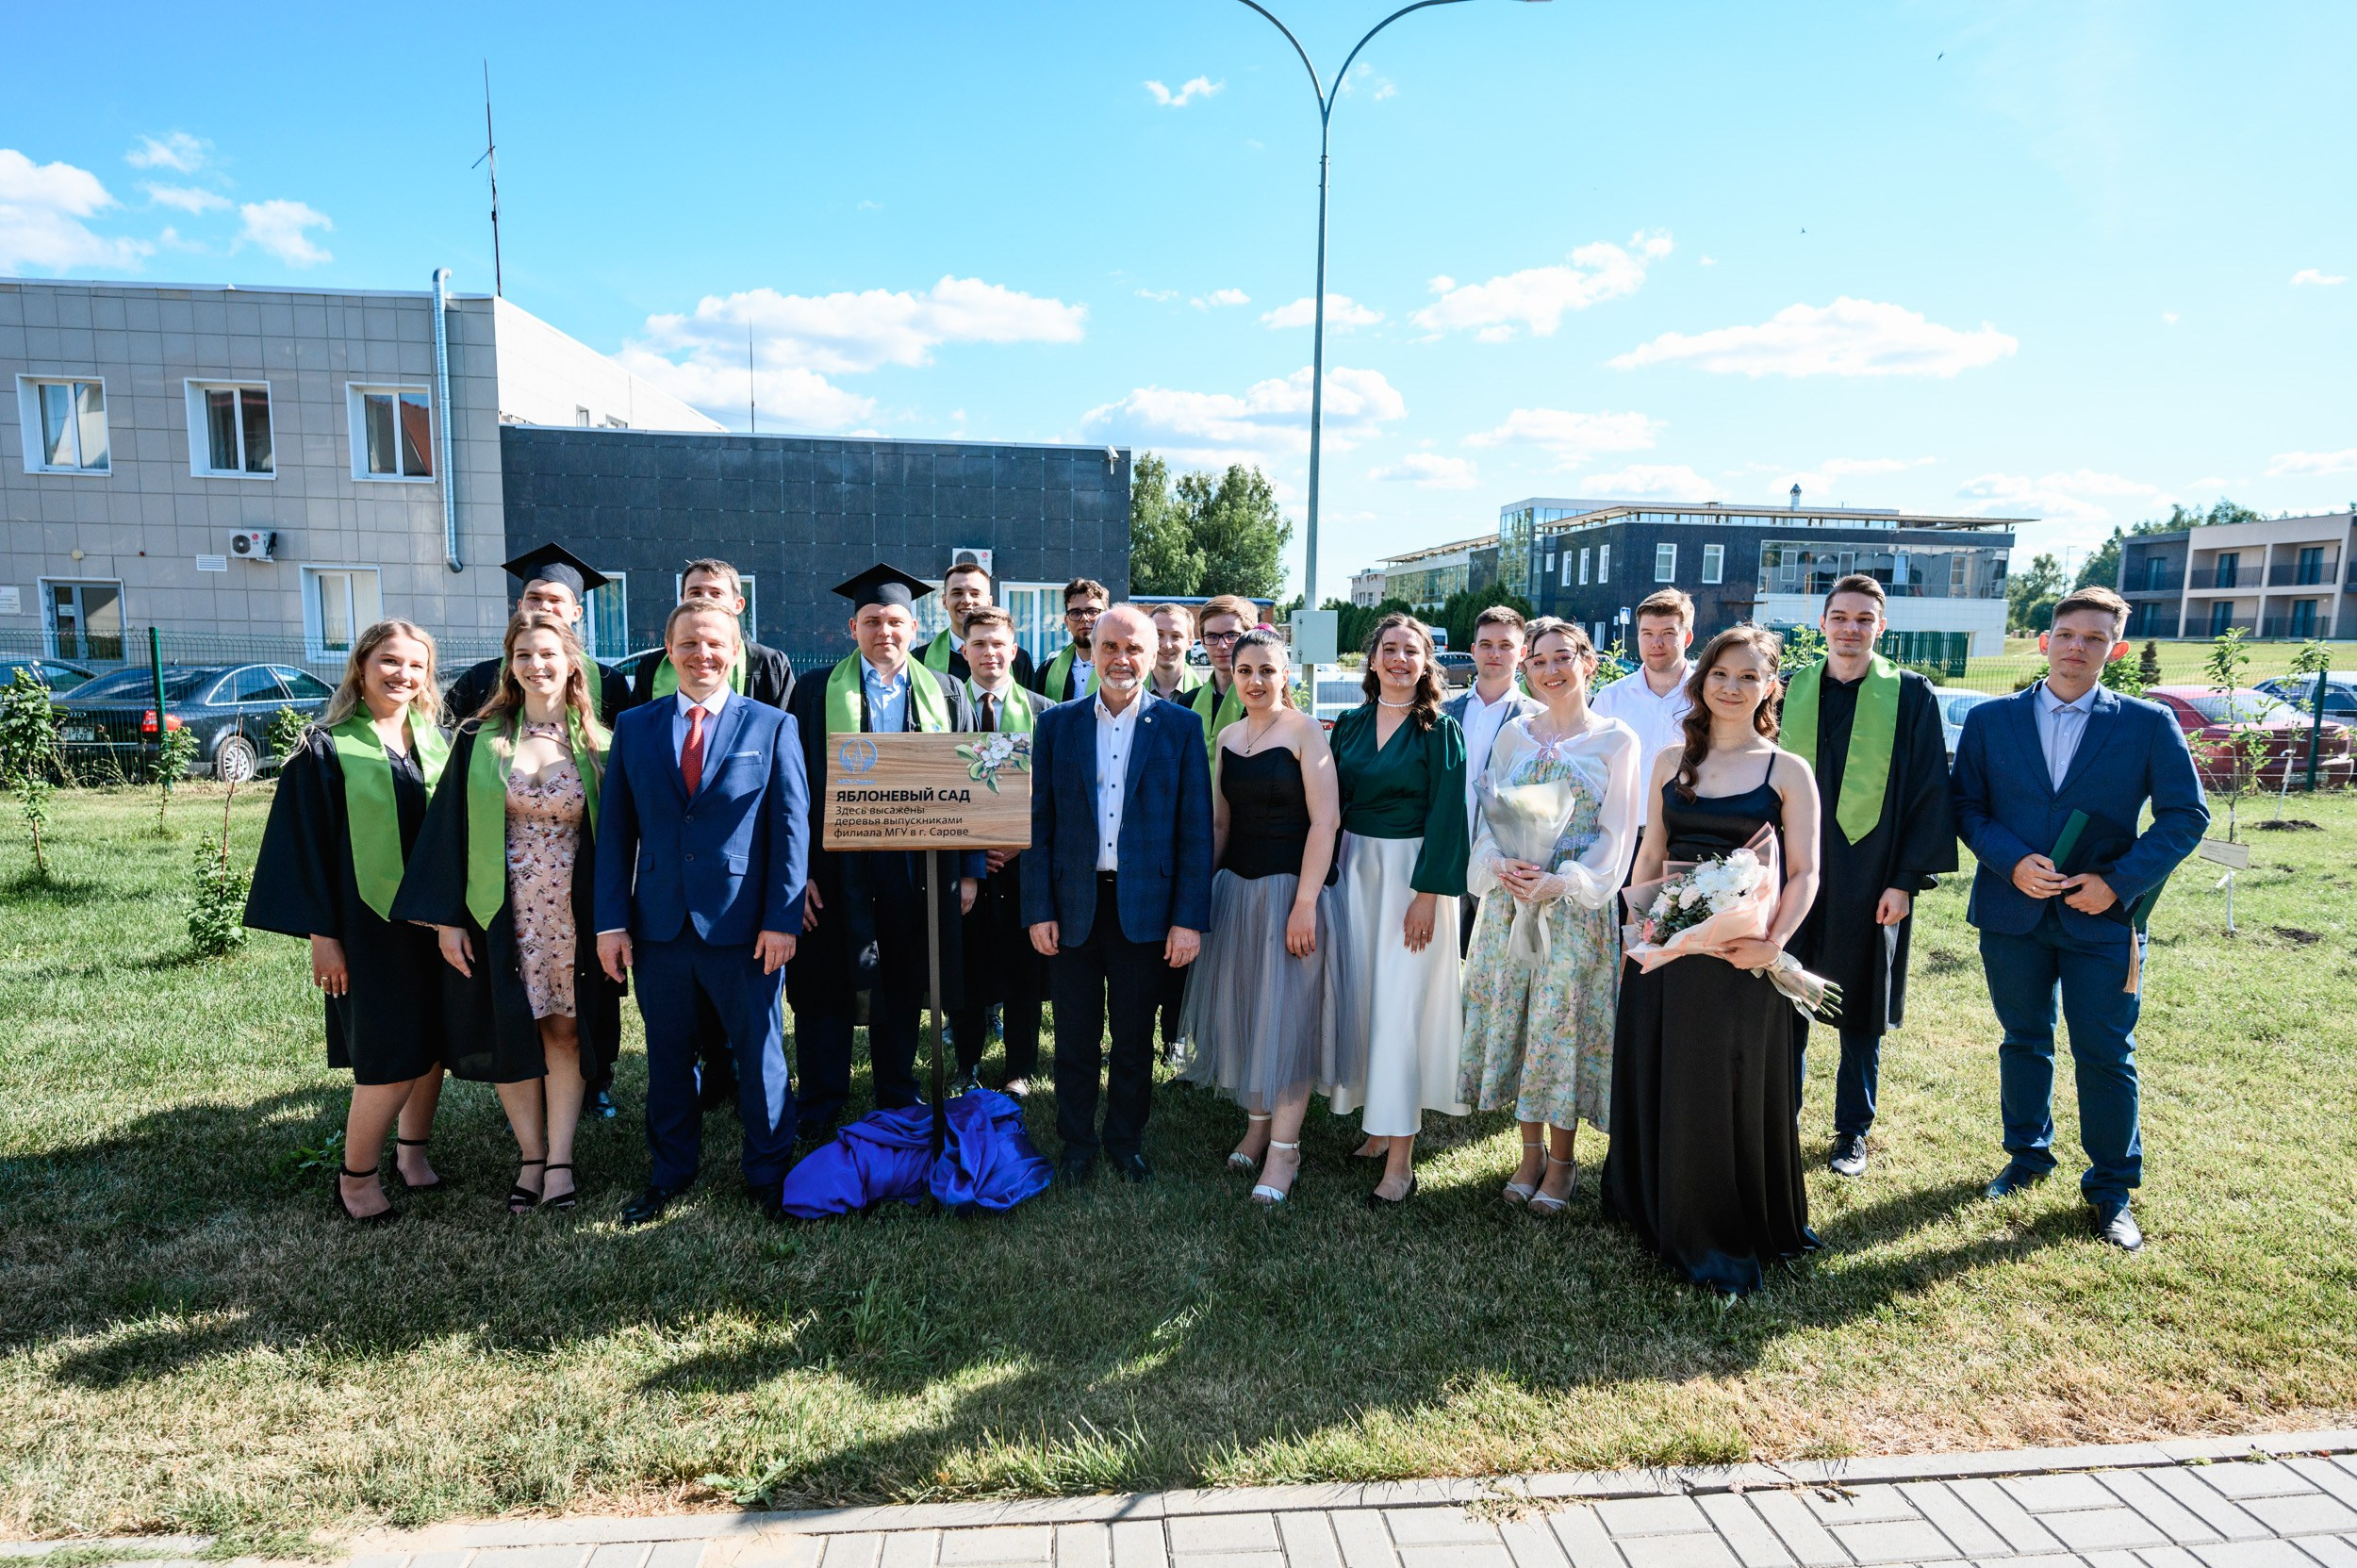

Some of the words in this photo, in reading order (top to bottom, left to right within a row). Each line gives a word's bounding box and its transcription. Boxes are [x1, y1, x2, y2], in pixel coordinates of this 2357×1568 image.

[836, 786, 934, 802] ЯБЛОНЕВЫЙ
[938, 789, 971, 803] САД
[835, 805, 867, 816] Здесь
[869, 806, 925, 815] высажены
[834, 817, 881, 827] деревья
[883, 817, 963, 827] выпускниками
[833, 828, 882, 839] филиала
[885, 828, 908, 837] МГУ
[929, 827, 969, 837] Сарове
